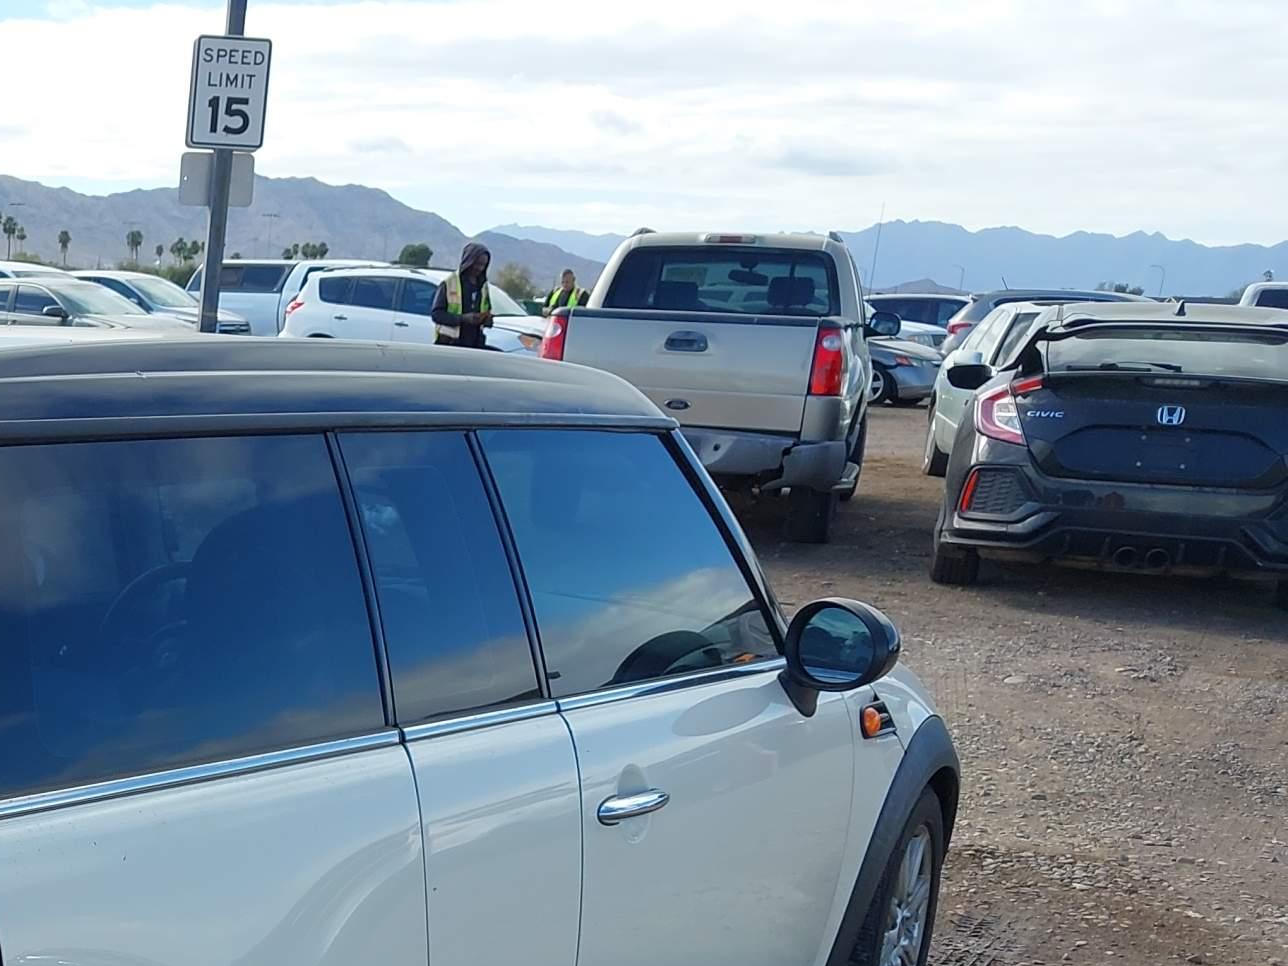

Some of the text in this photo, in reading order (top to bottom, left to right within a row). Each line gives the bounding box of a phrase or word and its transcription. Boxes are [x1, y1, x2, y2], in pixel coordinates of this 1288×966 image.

[202, 47, 265, 66] SPEED
[207, 71, 256, 90] LIMIT
[207, 95, 250, 135] 15
[1026, 410, 1065, 418] CIVIC
